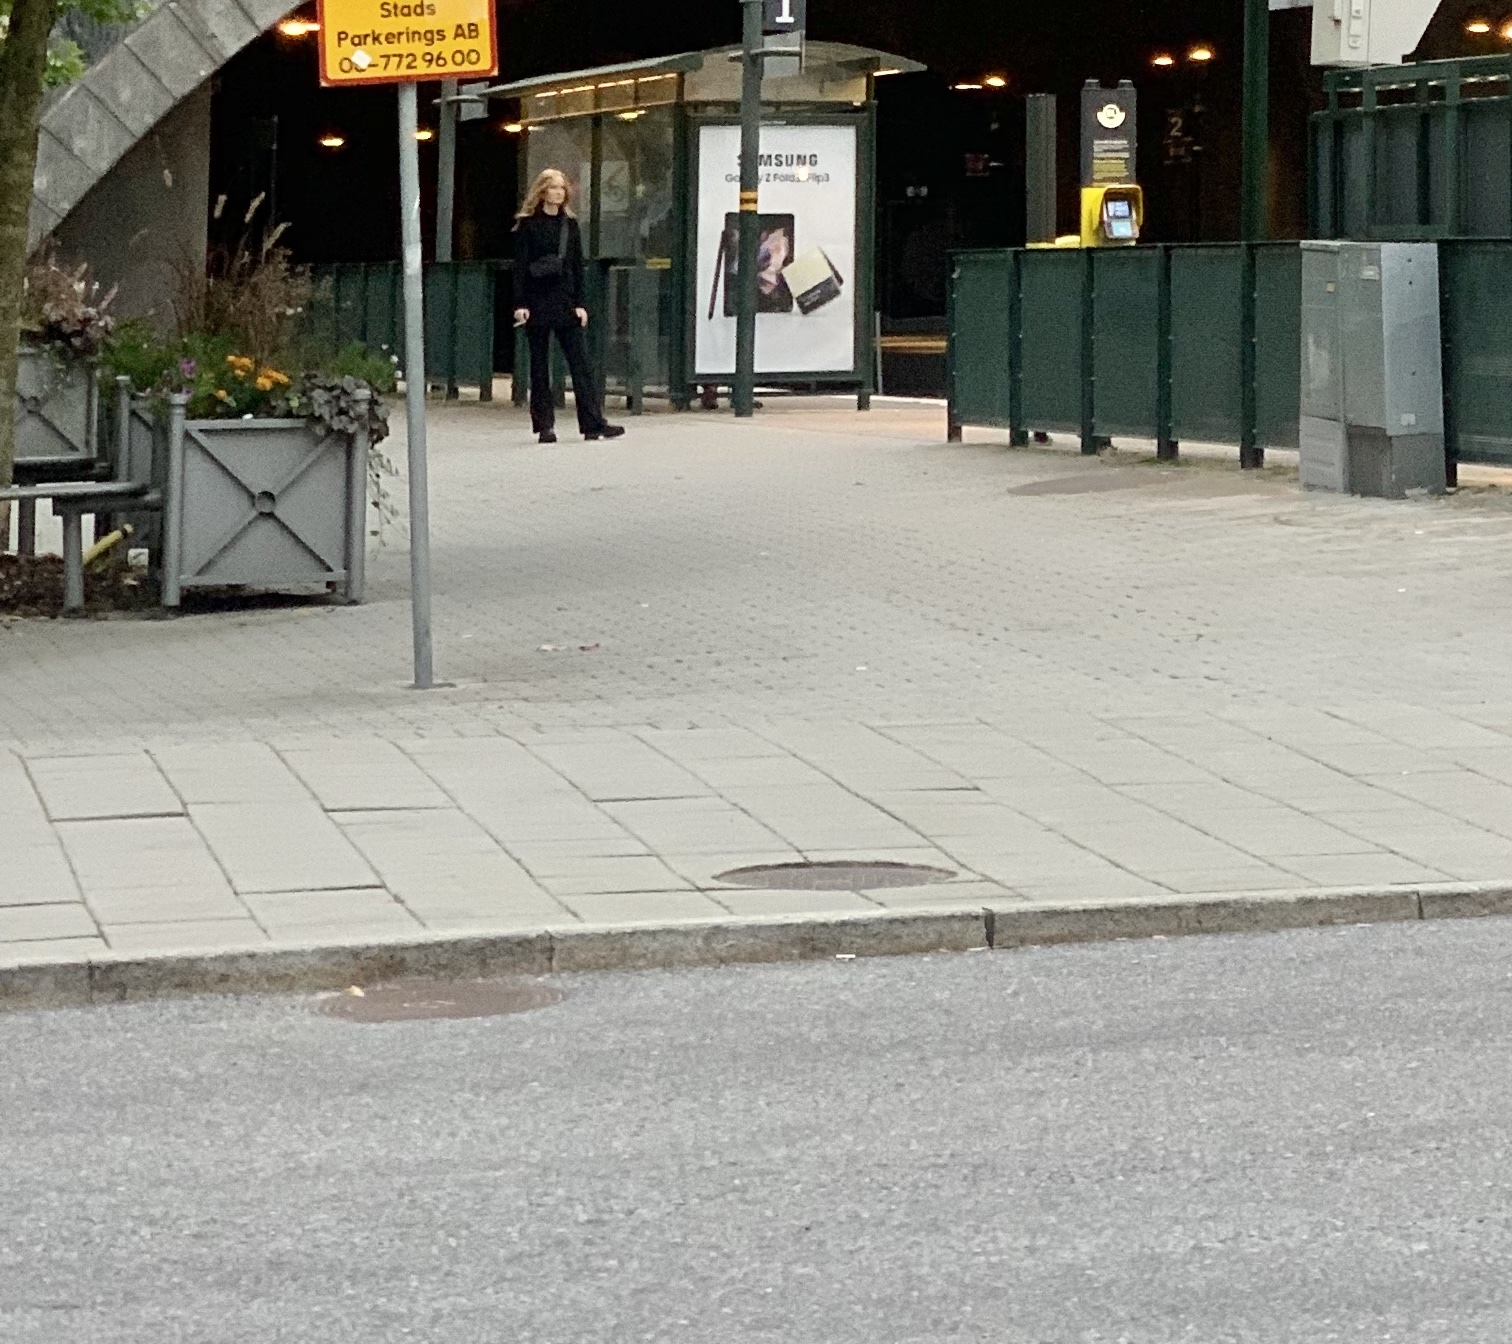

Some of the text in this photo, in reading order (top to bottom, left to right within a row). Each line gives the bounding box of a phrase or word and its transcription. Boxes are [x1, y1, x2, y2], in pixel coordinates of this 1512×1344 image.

[380, 0, 437, 18] Stads
[337, 22, 480, 47] Parkerings AB
[737, 153, 818, 167] MSUNG
